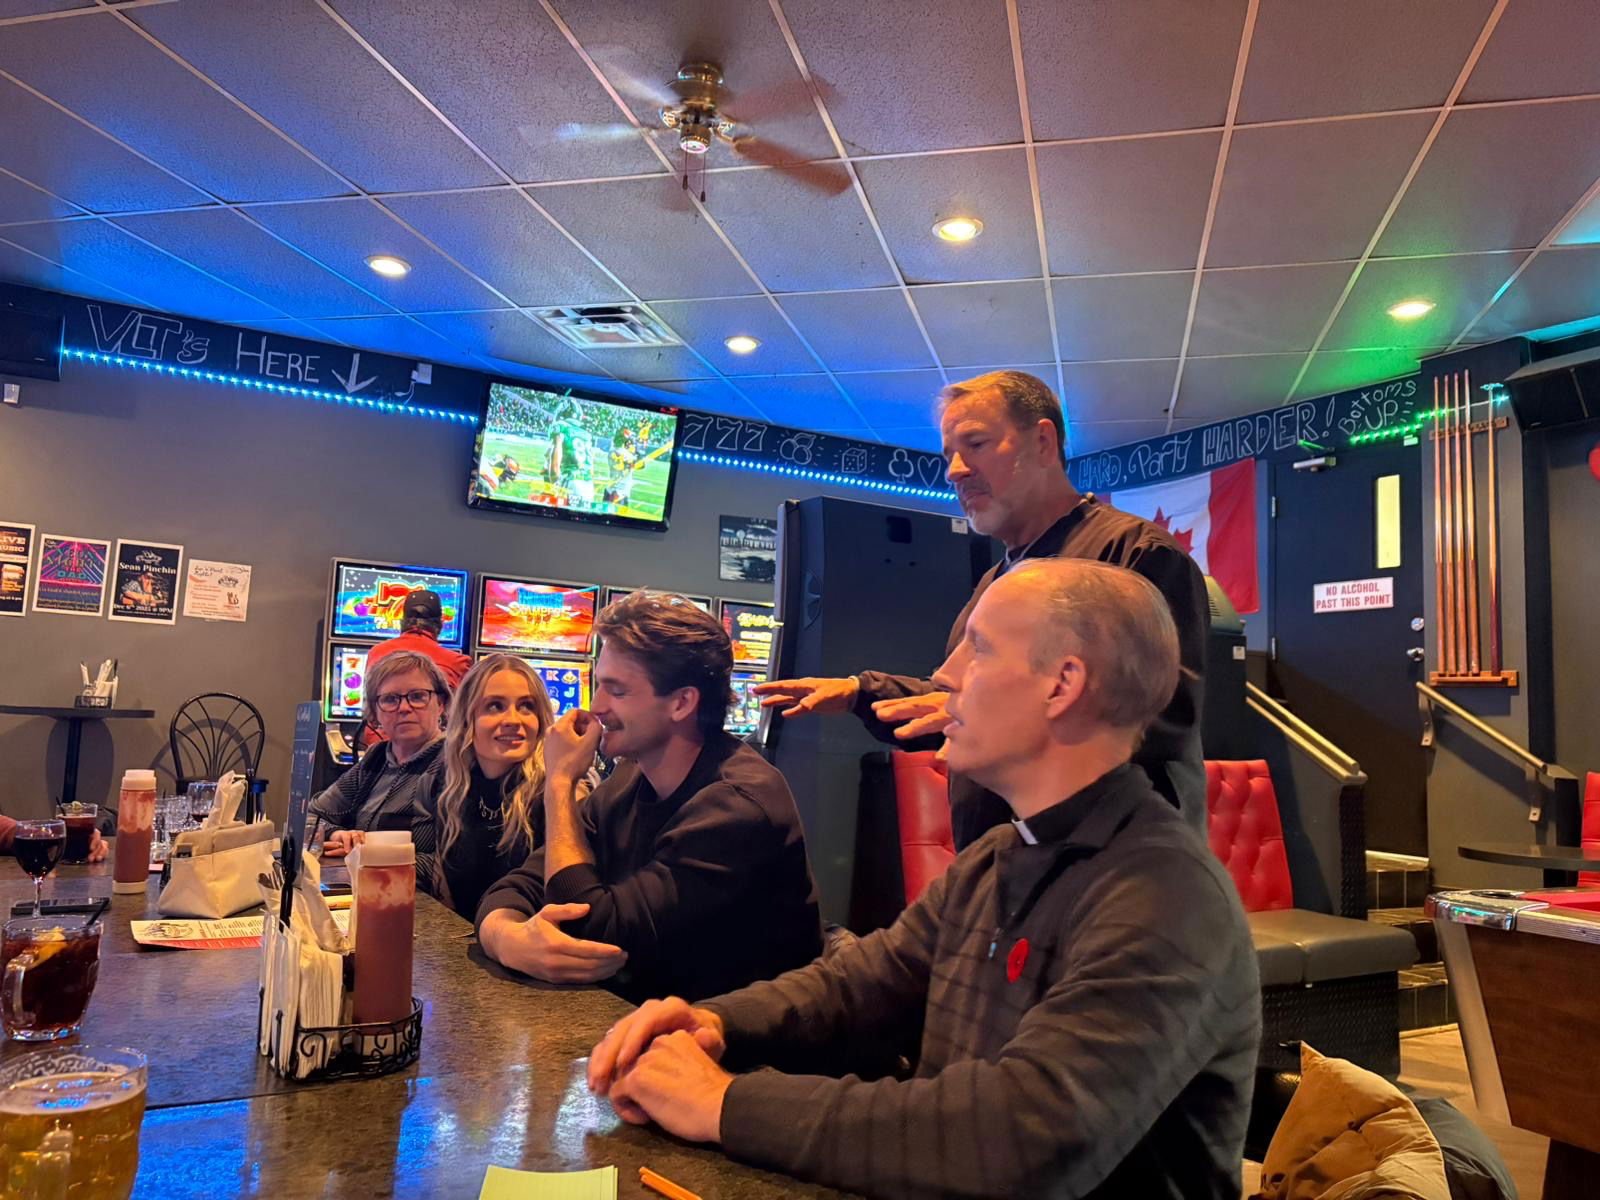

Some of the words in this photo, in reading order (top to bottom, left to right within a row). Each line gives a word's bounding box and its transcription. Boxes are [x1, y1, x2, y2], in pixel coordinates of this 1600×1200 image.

[86, 304, 210, 364] VLT's
[236, 331, 321, 383] HERE
[1202, 396, 1335, 466] HARDER!
[118, 561, 141, 572] Sean
[142, 563, 177, 575] Pinchin
[1326, 585, 1338, 596] NO
[1341, 582, 1380, 595] ALCOHOL
[1316, 598, 1338, 609] PAST
[1341, 596, 1361, 608] THIS
[1364, 593, 1391, 606] POINT
